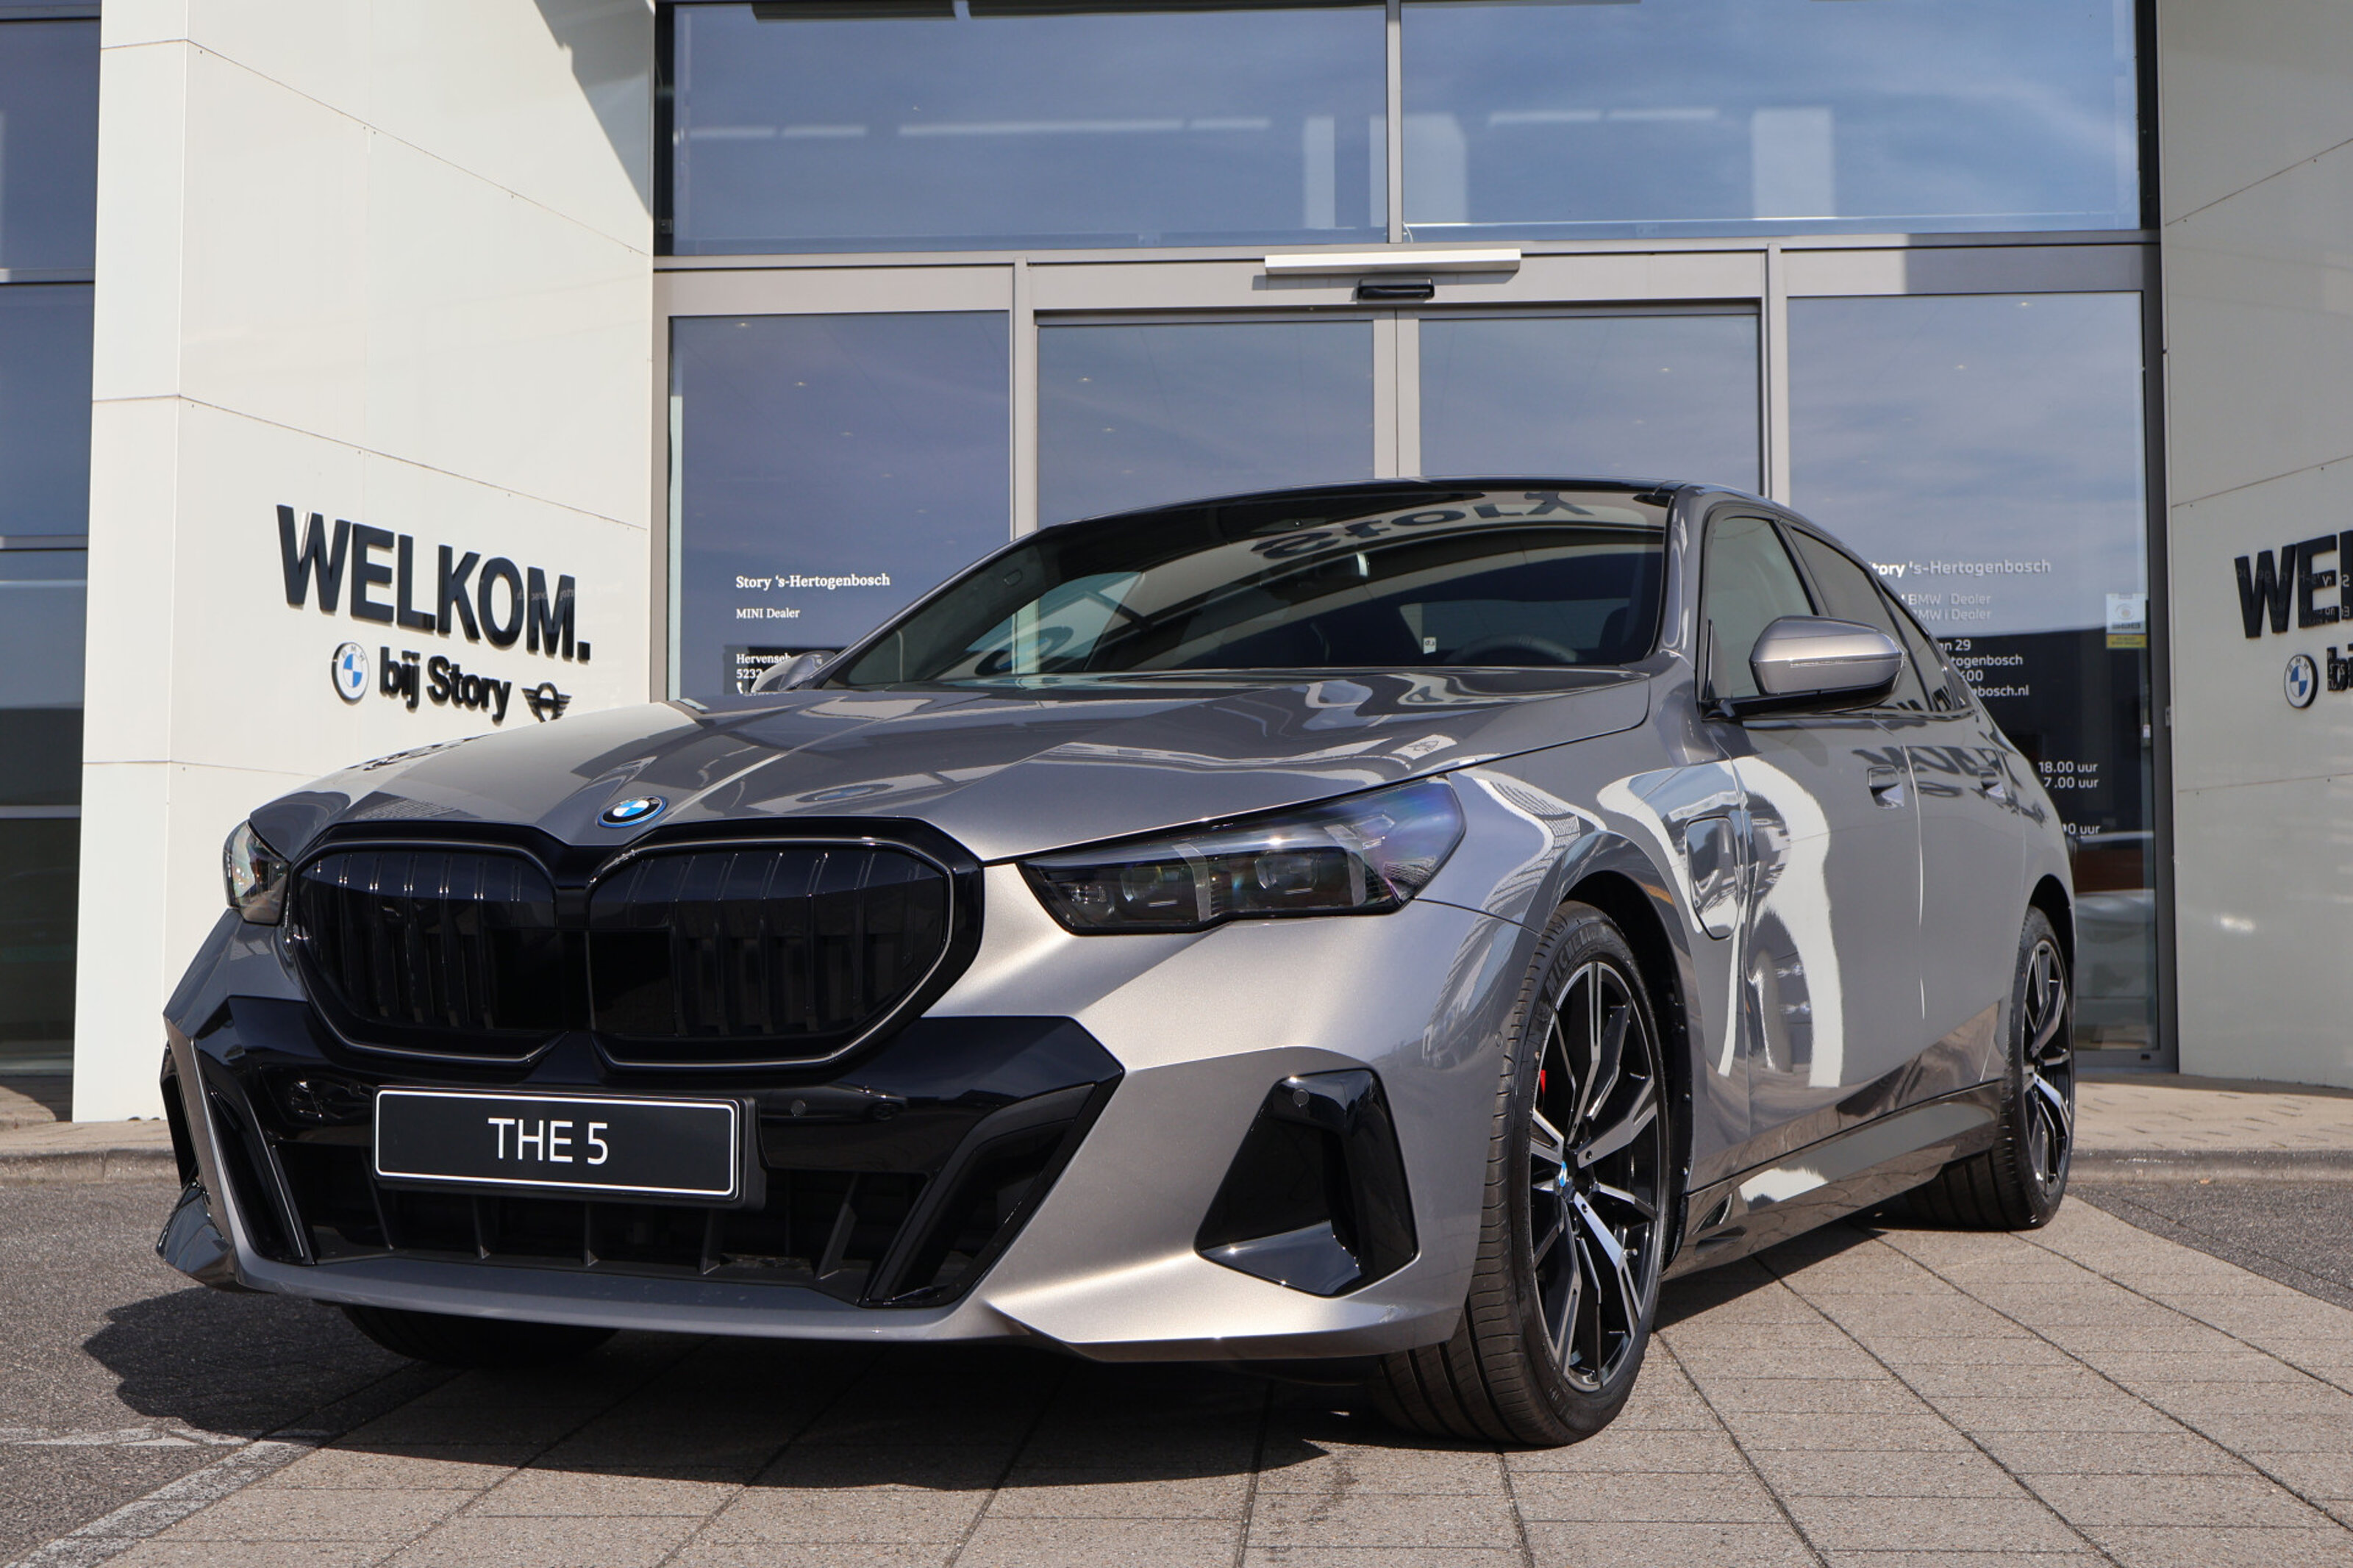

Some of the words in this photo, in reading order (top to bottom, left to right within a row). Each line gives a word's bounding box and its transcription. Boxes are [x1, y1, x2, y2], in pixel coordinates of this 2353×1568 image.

[1868, 561, 1905, 578] tory
[276, 504, 590, 664] WELKOM.
[736, 576, 771, 590] Story
[1908, 593, 1941, 606] BMW
[1951, 593, 1992, 605] Dealer
[736, 609, 763, 619] MINI
[767, 608, 800, 619] Dealer
[1951, 608, 1992, 620] Dealer
[1954, 639, 1971, 651] 29
[379, 645, 421, 712] bij
[426, 655, 513, 724] Story
[2038, 761, 2074, 774] 18.00
[2077, 763, 2099, 773] uur
[2078, 778, 2099, 789] uur
[2079, 825, 2101, 835] uur
[488, 1117, 574, 1162] THE
[588, 1121, 609, 1165] 5
